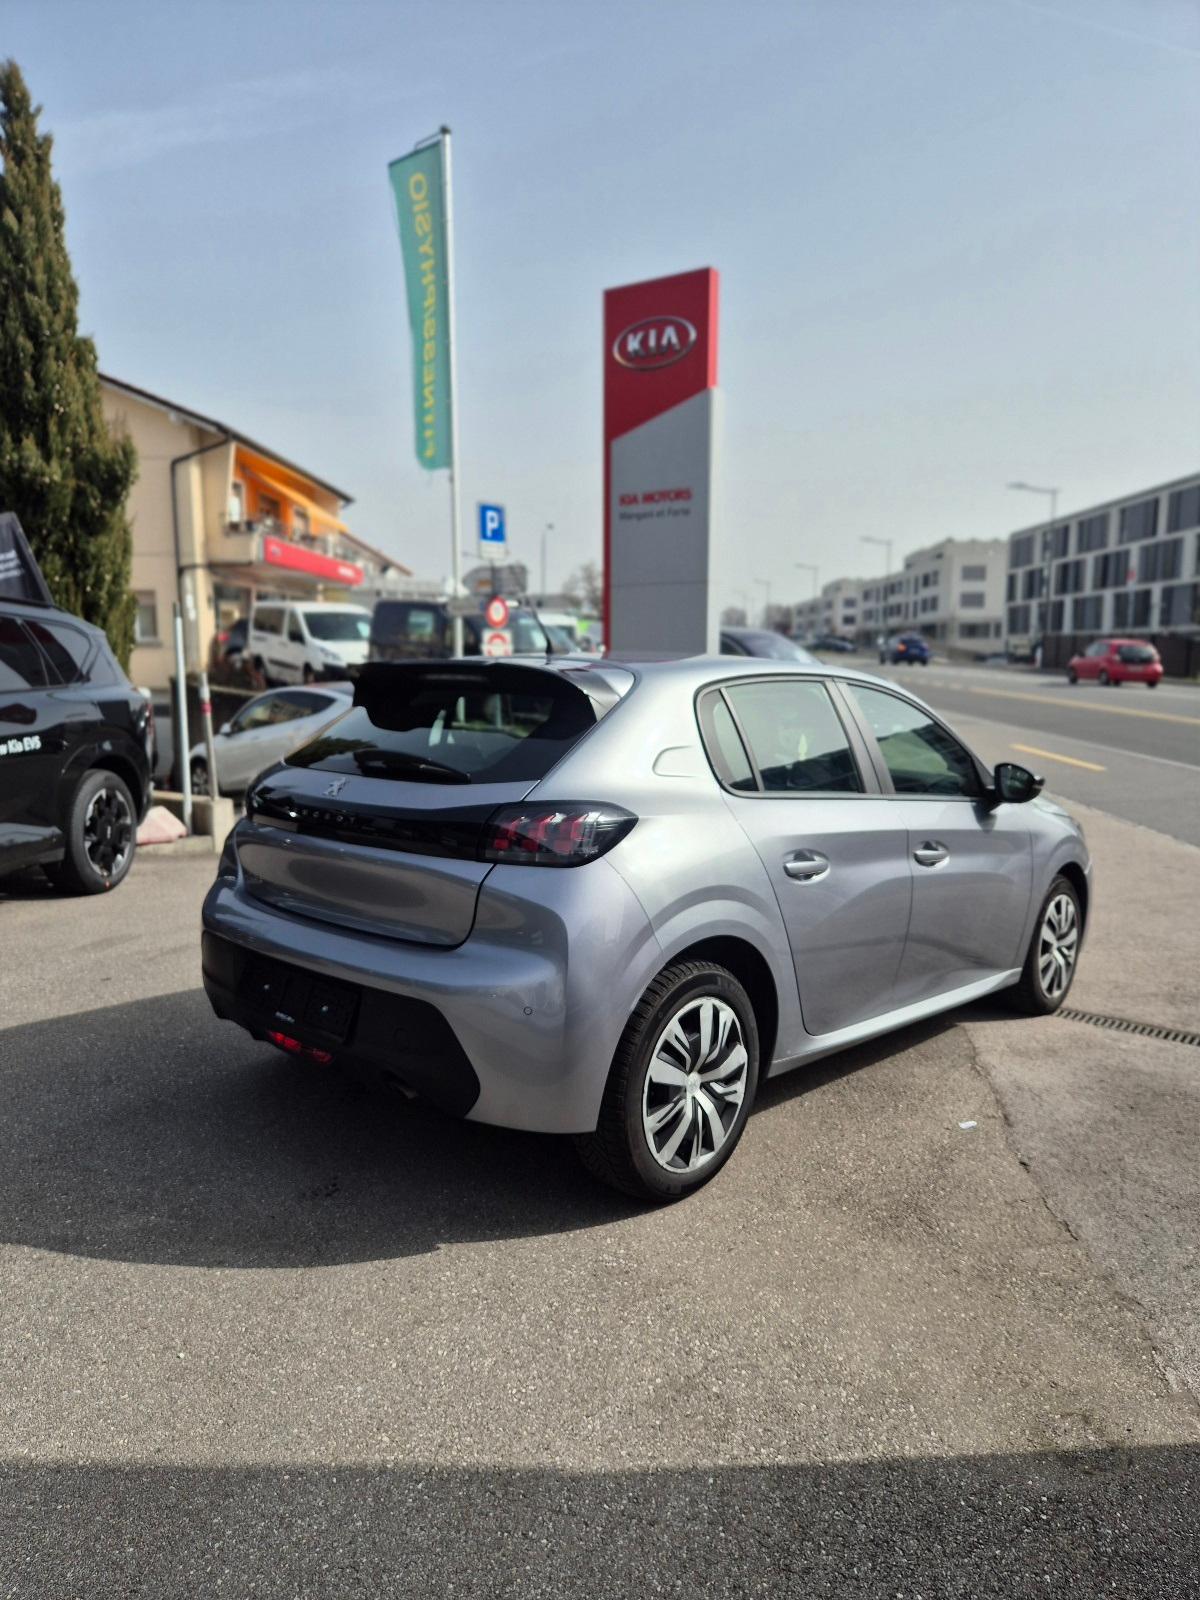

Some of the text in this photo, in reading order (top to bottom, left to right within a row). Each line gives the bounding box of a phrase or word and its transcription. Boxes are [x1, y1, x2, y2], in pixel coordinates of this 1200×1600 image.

[627, 325, 681, 356] KIA
[619, 488, 693, 507] KIA MOTORS
[486, 510, 499, 538] P
